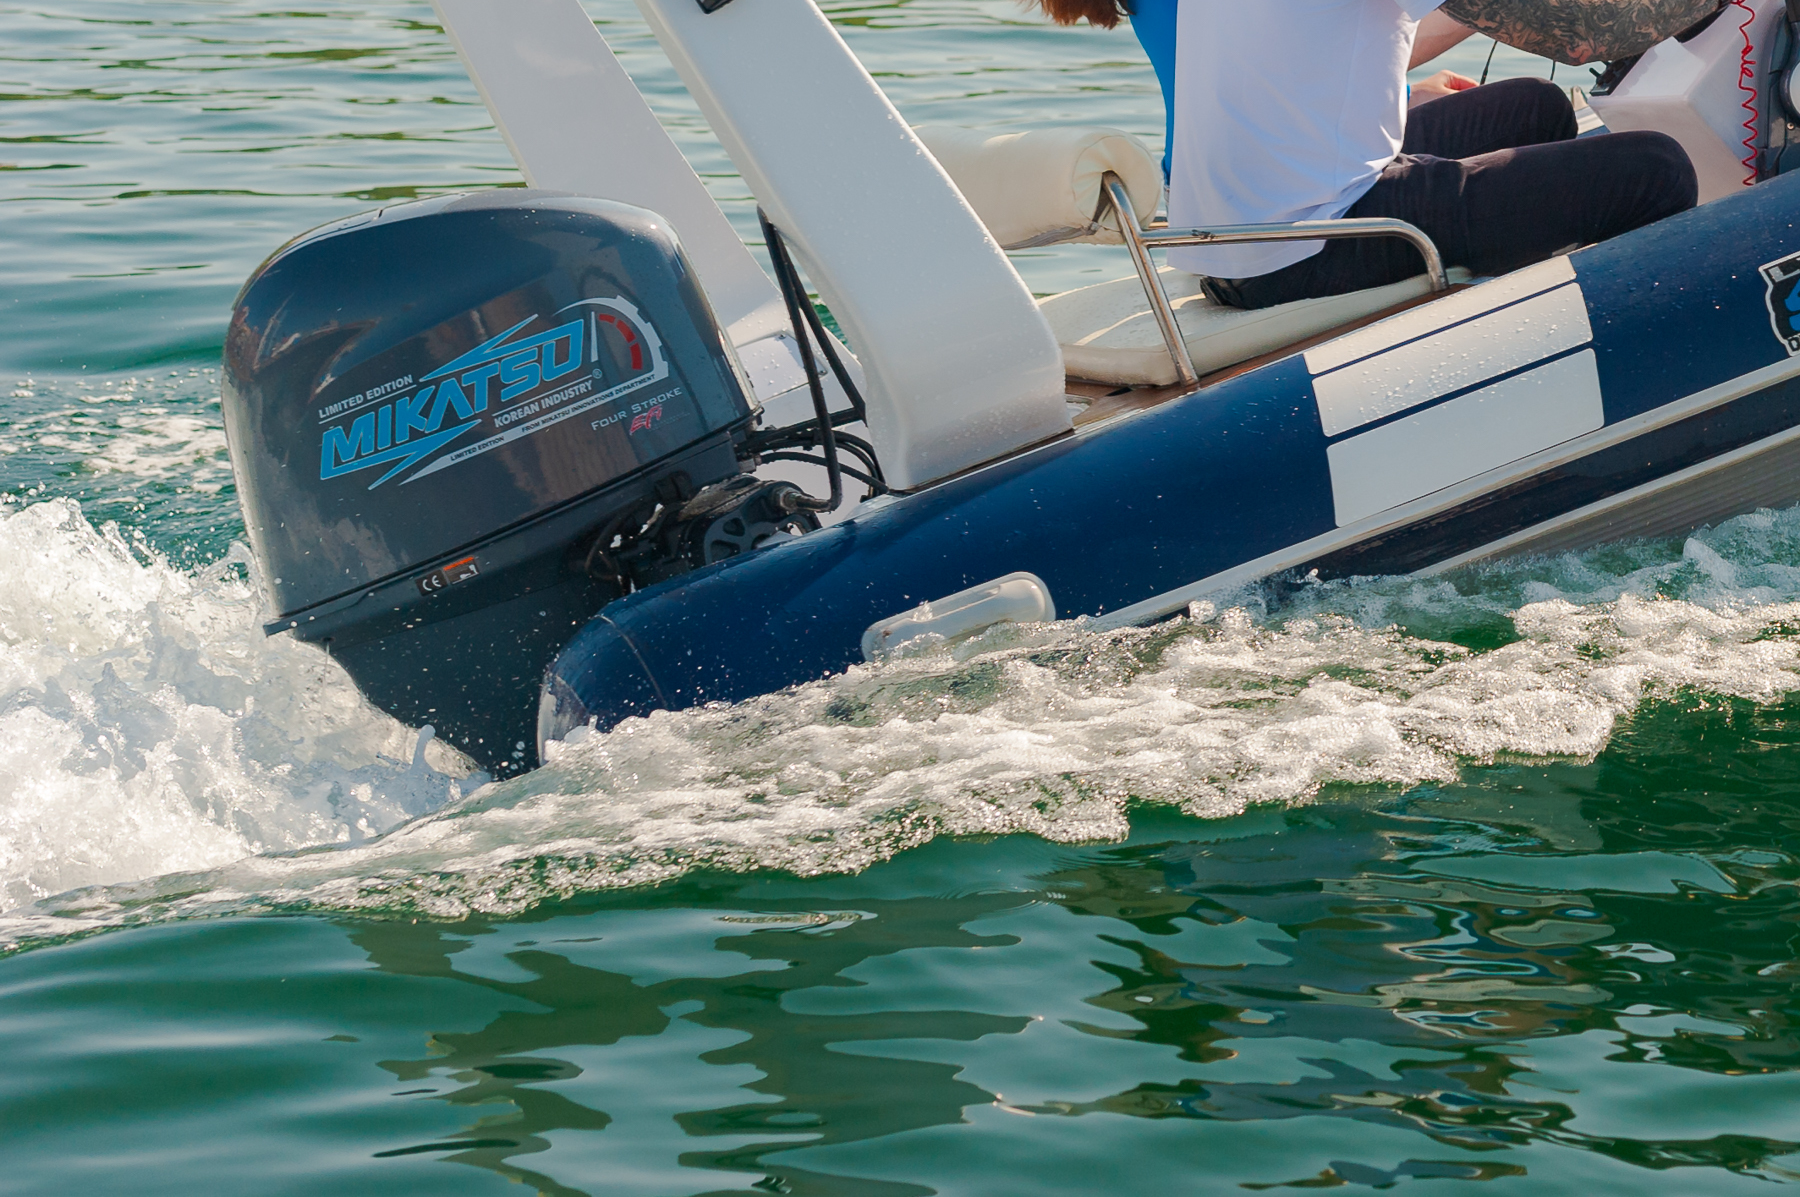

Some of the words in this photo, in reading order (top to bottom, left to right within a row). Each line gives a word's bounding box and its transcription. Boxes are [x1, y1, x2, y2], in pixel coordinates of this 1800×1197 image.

[318, 394, 364, 419] LIMITED
[366, 374, 413, 399] EDITION
[320, 315, 585, 484] MIKATSU
[494, 404, 541, 428] KOREAN
[541, 379, 593, 409] INDUSTRY
[591, 410, 628, 431] FOUR
[631, 387, 683, 413] STROKE
[450, 445, 477, 461] LIMITED
[477, 435, 505, 452] EDITION
[521, 420, 541, 434] FROM
